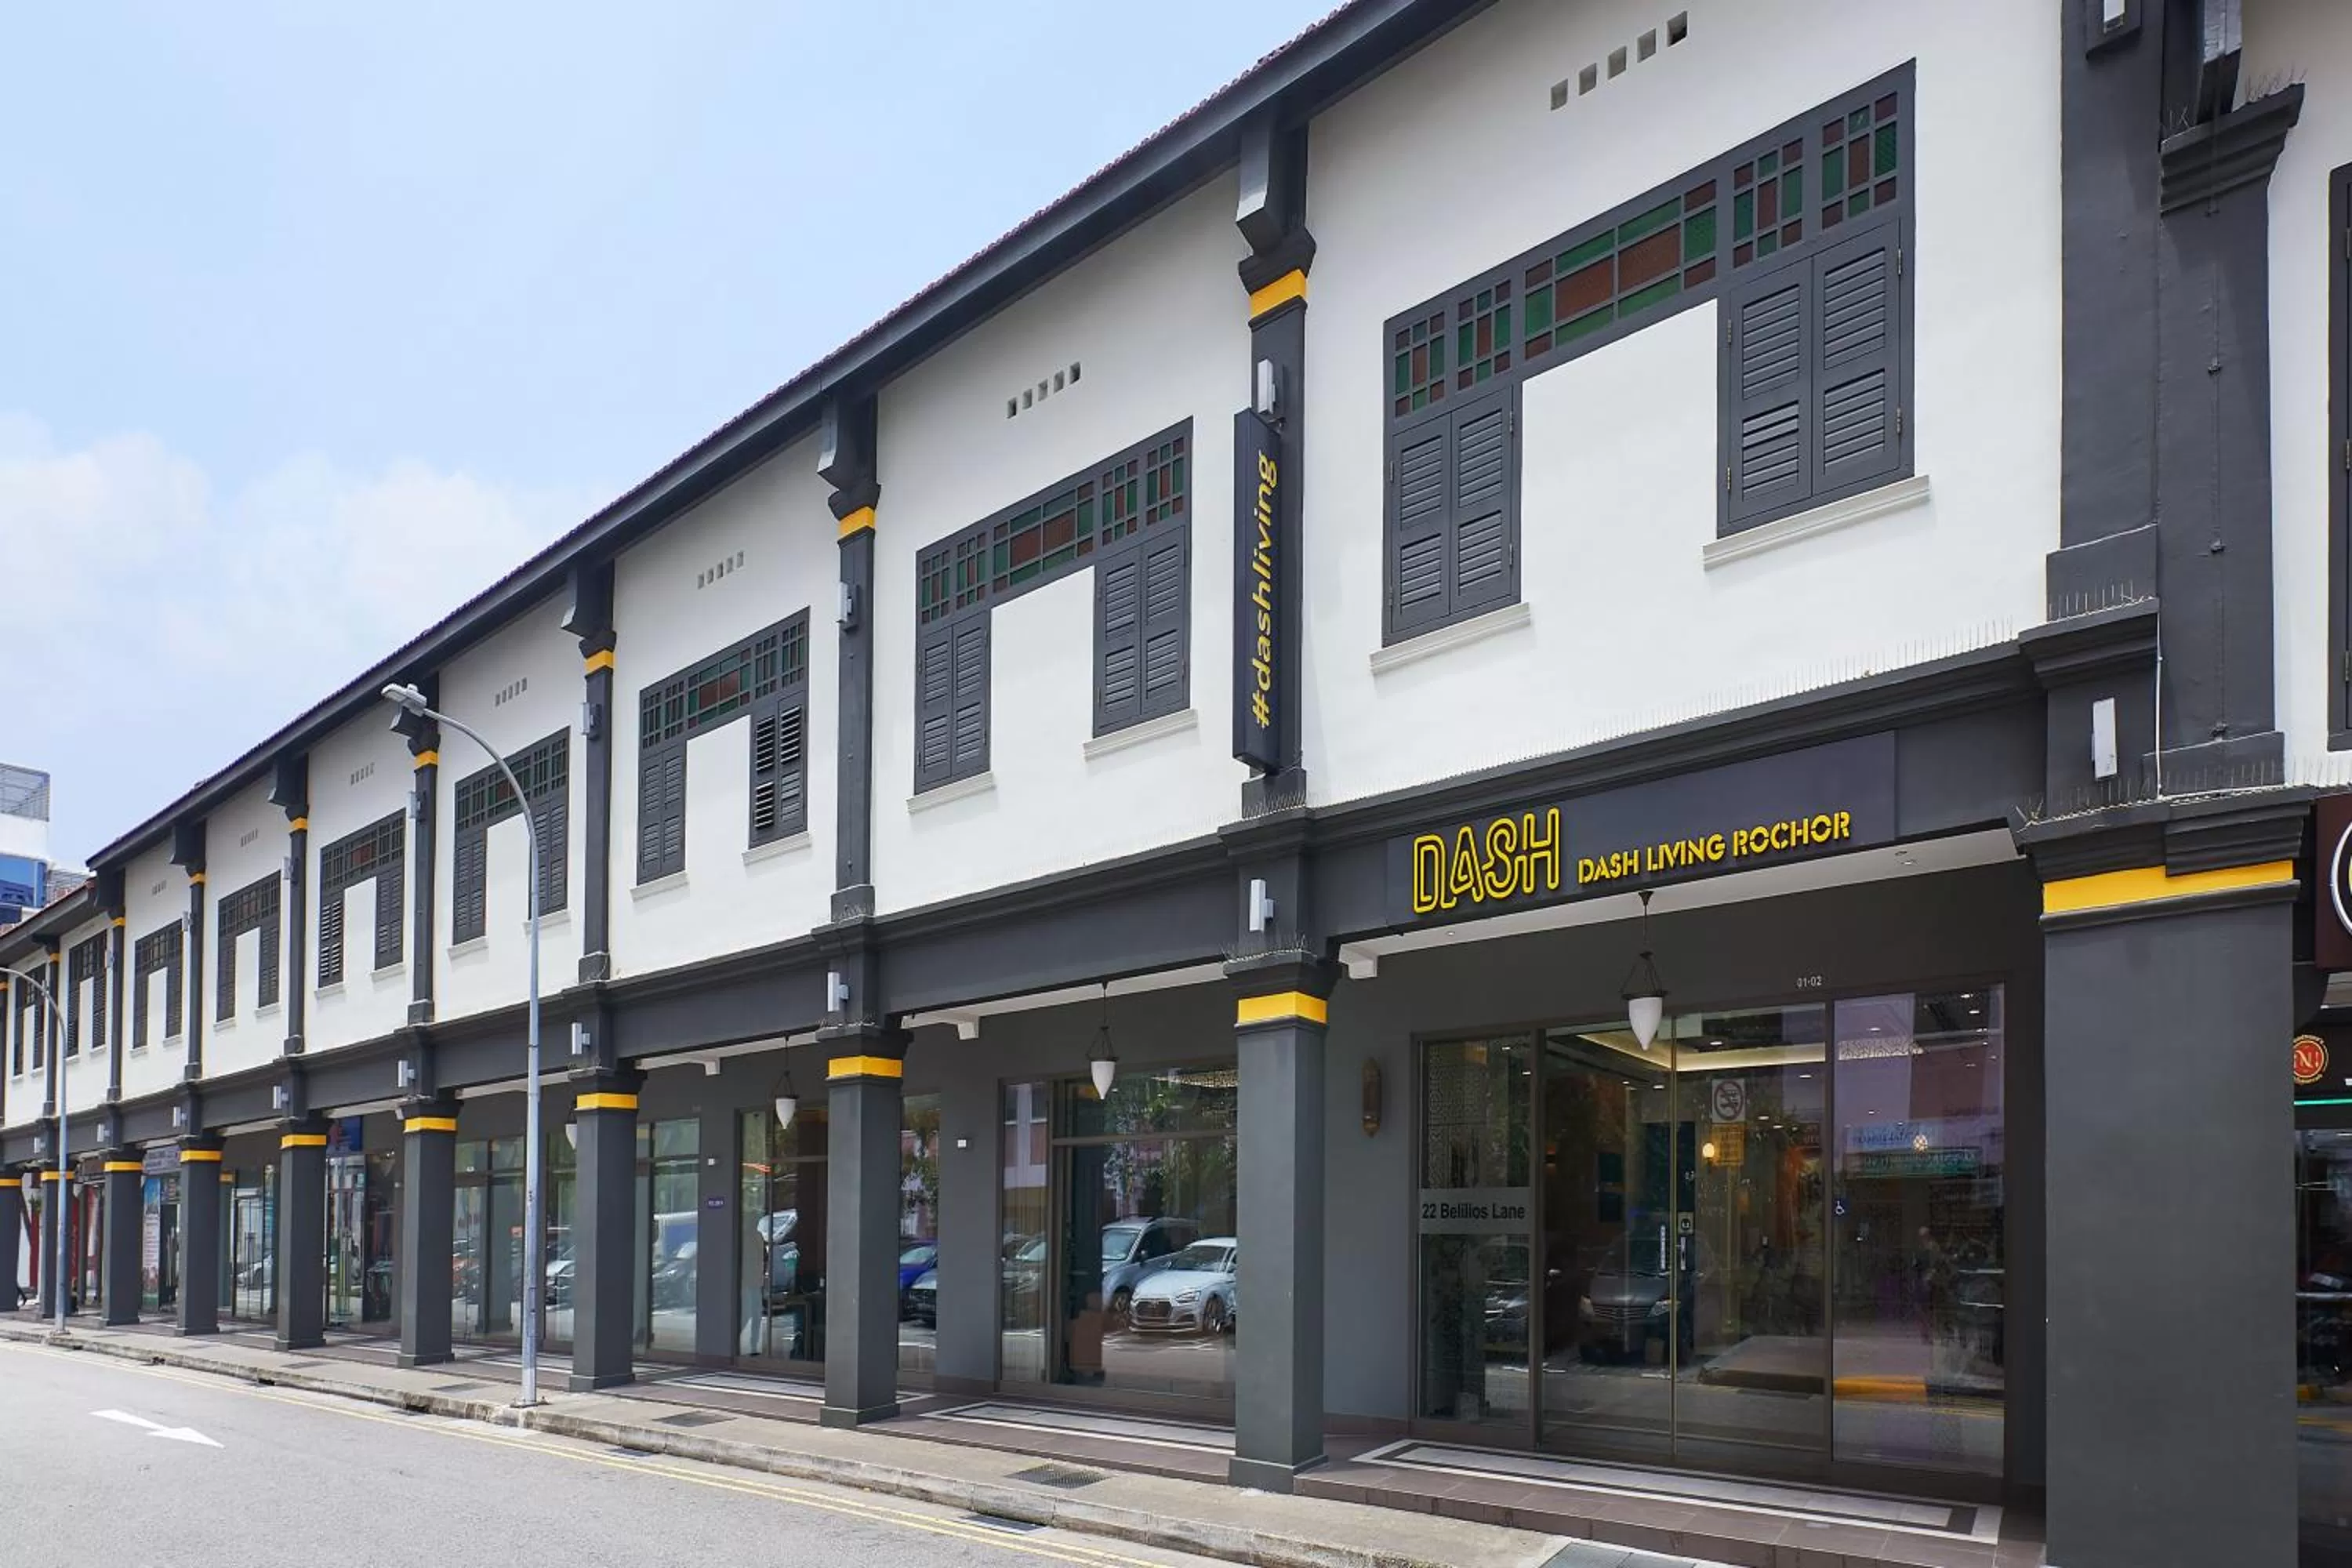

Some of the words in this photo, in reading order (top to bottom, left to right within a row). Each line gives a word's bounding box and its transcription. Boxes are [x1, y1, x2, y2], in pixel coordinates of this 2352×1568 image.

[1251, 448, 1278, 729] #dashliving
[1413, 807, 1560, 914] DASH
[1577, 851, 1640, 884] DASH
[1646, 833, 1726, 873] LIVING
[1732, 811, 1851, 857] ROCHOR
[1421, 1203, 1437, 1219] 22
[1491, 1202, 1526, 1219] Lane
